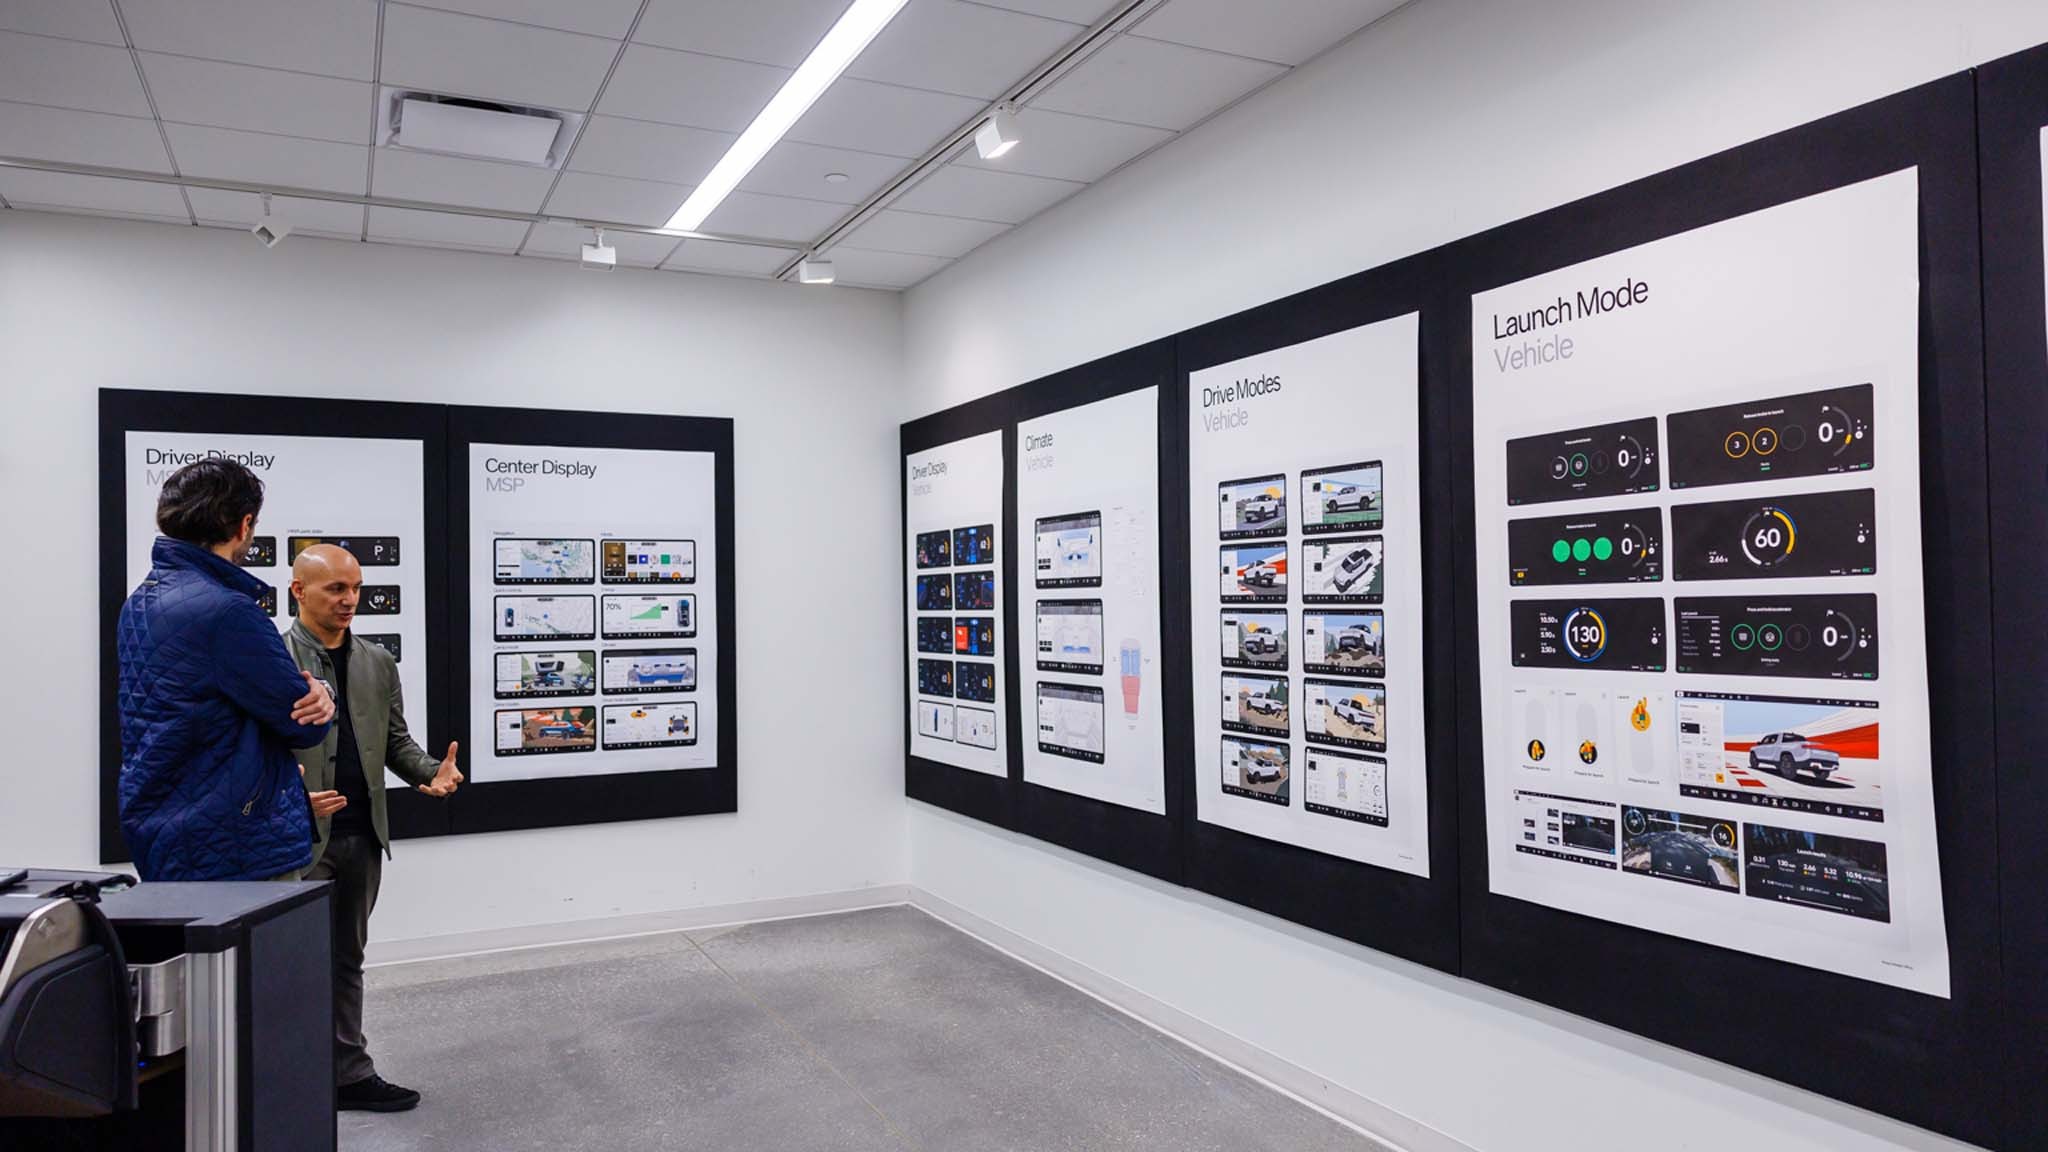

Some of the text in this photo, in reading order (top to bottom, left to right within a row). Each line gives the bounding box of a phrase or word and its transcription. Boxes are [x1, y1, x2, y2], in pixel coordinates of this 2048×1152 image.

[1493, 277, 1649, 340] Launch Mode
[1493, 333, 1574, 373] Vehicle
[1203, 373, 1282, 408] Drive Modes
[1203, 408, 1249, 433] Vehicle
[1025, 432, 1054, 451] Climate
[1818, 422, 1833, 443] 0
[146, 447, 204, 466] Driver
[1618, 449, 1629, 467] 0
[485, 457, 598, 479] Center Display
[486, 477, 525, 492] MSP
[1621, 537, 1633, 555] 0
[1754, 527, 1781, 549] 60
[374, 545, 384, 556] P
[374, 595, 385, 604] 59
[605, 602, 622, 611] 70%
[1571, 626, 1600, 643] 130
[1823, 626, 1838, 647] 0
